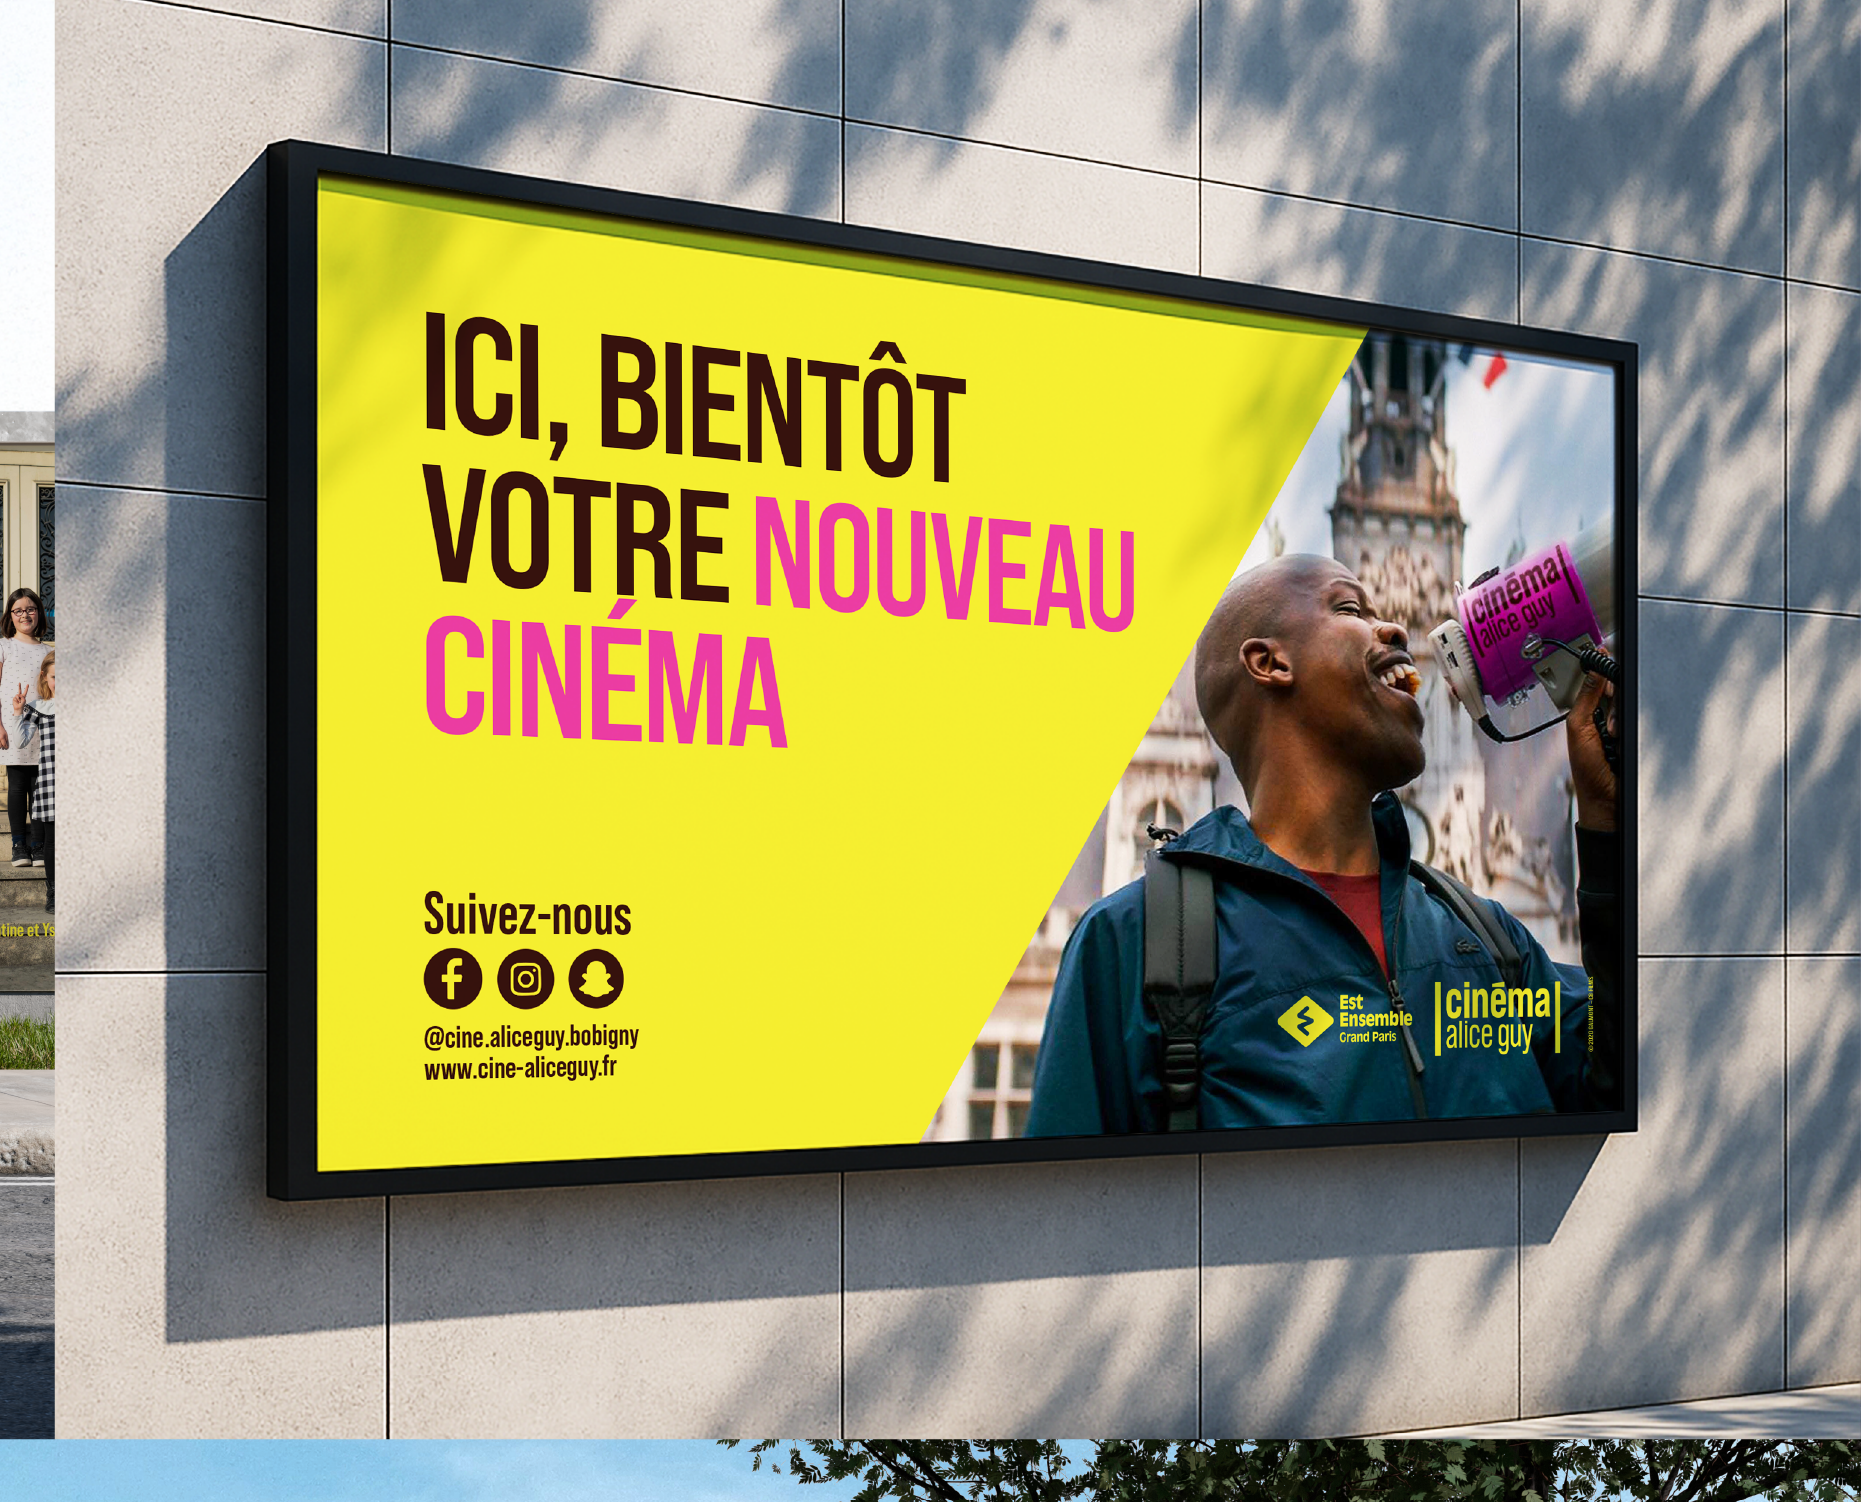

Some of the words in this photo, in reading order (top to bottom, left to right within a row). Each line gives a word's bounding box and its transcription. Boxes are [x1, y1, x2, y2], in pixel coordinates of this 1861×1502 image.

[425, 311, 568, 462] ICI,
[600, 333, 967, 483] BIENTÔT
[422, 464, 730, 604] VOTRE
[755, 496, 1136, 633] NOUVEAU
[1480, 611, 1522, 649] alice
[1521, 591, 1556, 630] guy
[425, 598, 789, 749] CINÉMA
[26, 923, 40, 938] et
[424, 890, 632, 936] Suivez-nous
[1339, 993, 1364, 1011] Est
[1339, 1009, 1413, 1028] Ensemble
[1445, 981, 1552, 1020] cinéma
[424, 1023, 640, 1052] @cine.aliceguy.bobigny
[1339, 1030, 1371, 1044] Grand
[1372, 1030, 1397, 1043] Paris
[1445, 1020, 1494, 1049] alice
[1498, 1022, 1534, 1056] guy
[424, 1053, 618, 1083] www.cine-aliceguy.fr
